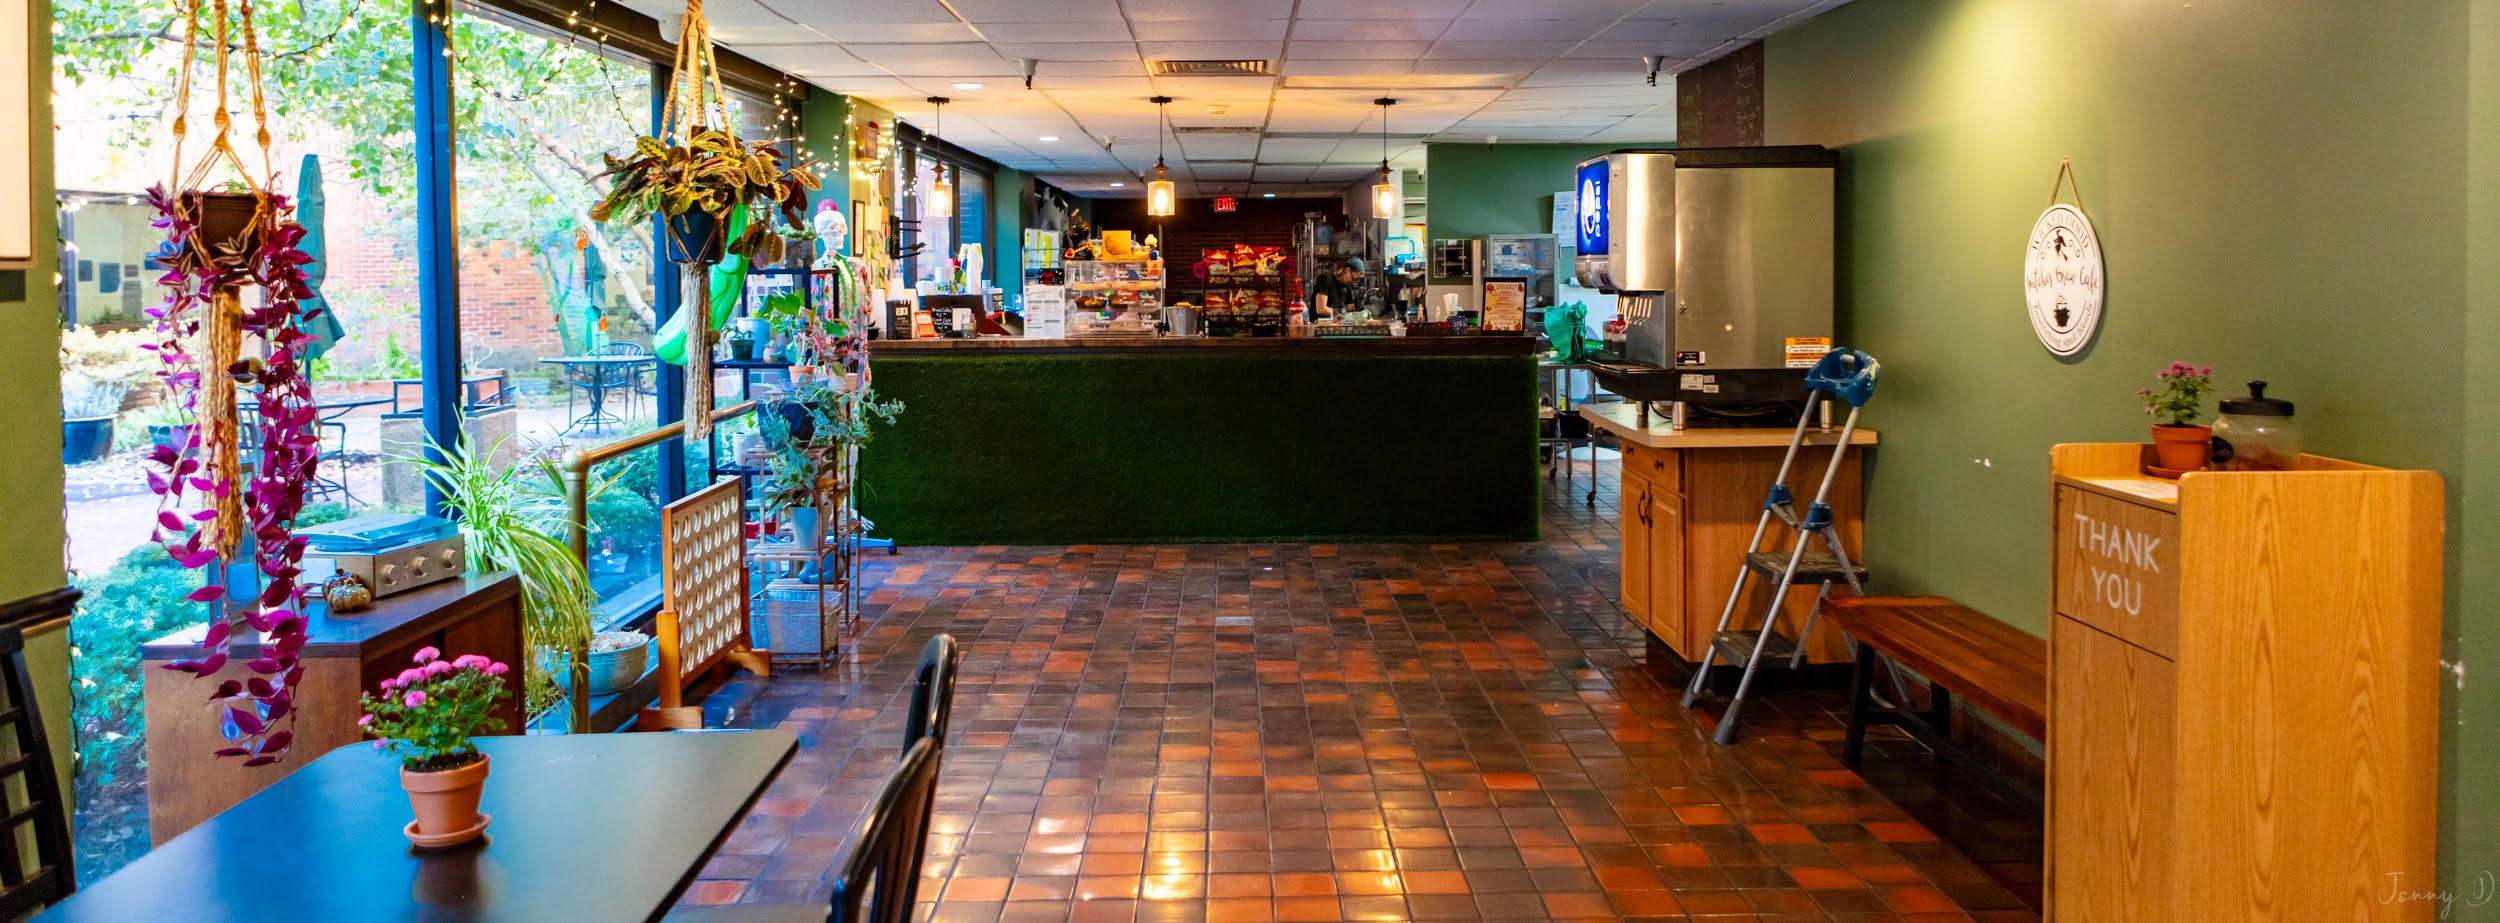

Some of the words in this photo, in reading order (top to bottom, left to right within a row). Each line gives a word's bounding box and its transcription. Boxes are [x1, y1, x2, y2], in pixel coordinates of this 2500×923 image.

[1217, 197, 1233, 211] EXIT
[2074, 512, 2160, 574] THANK
[2091, 566, 2142, 616] YOU
